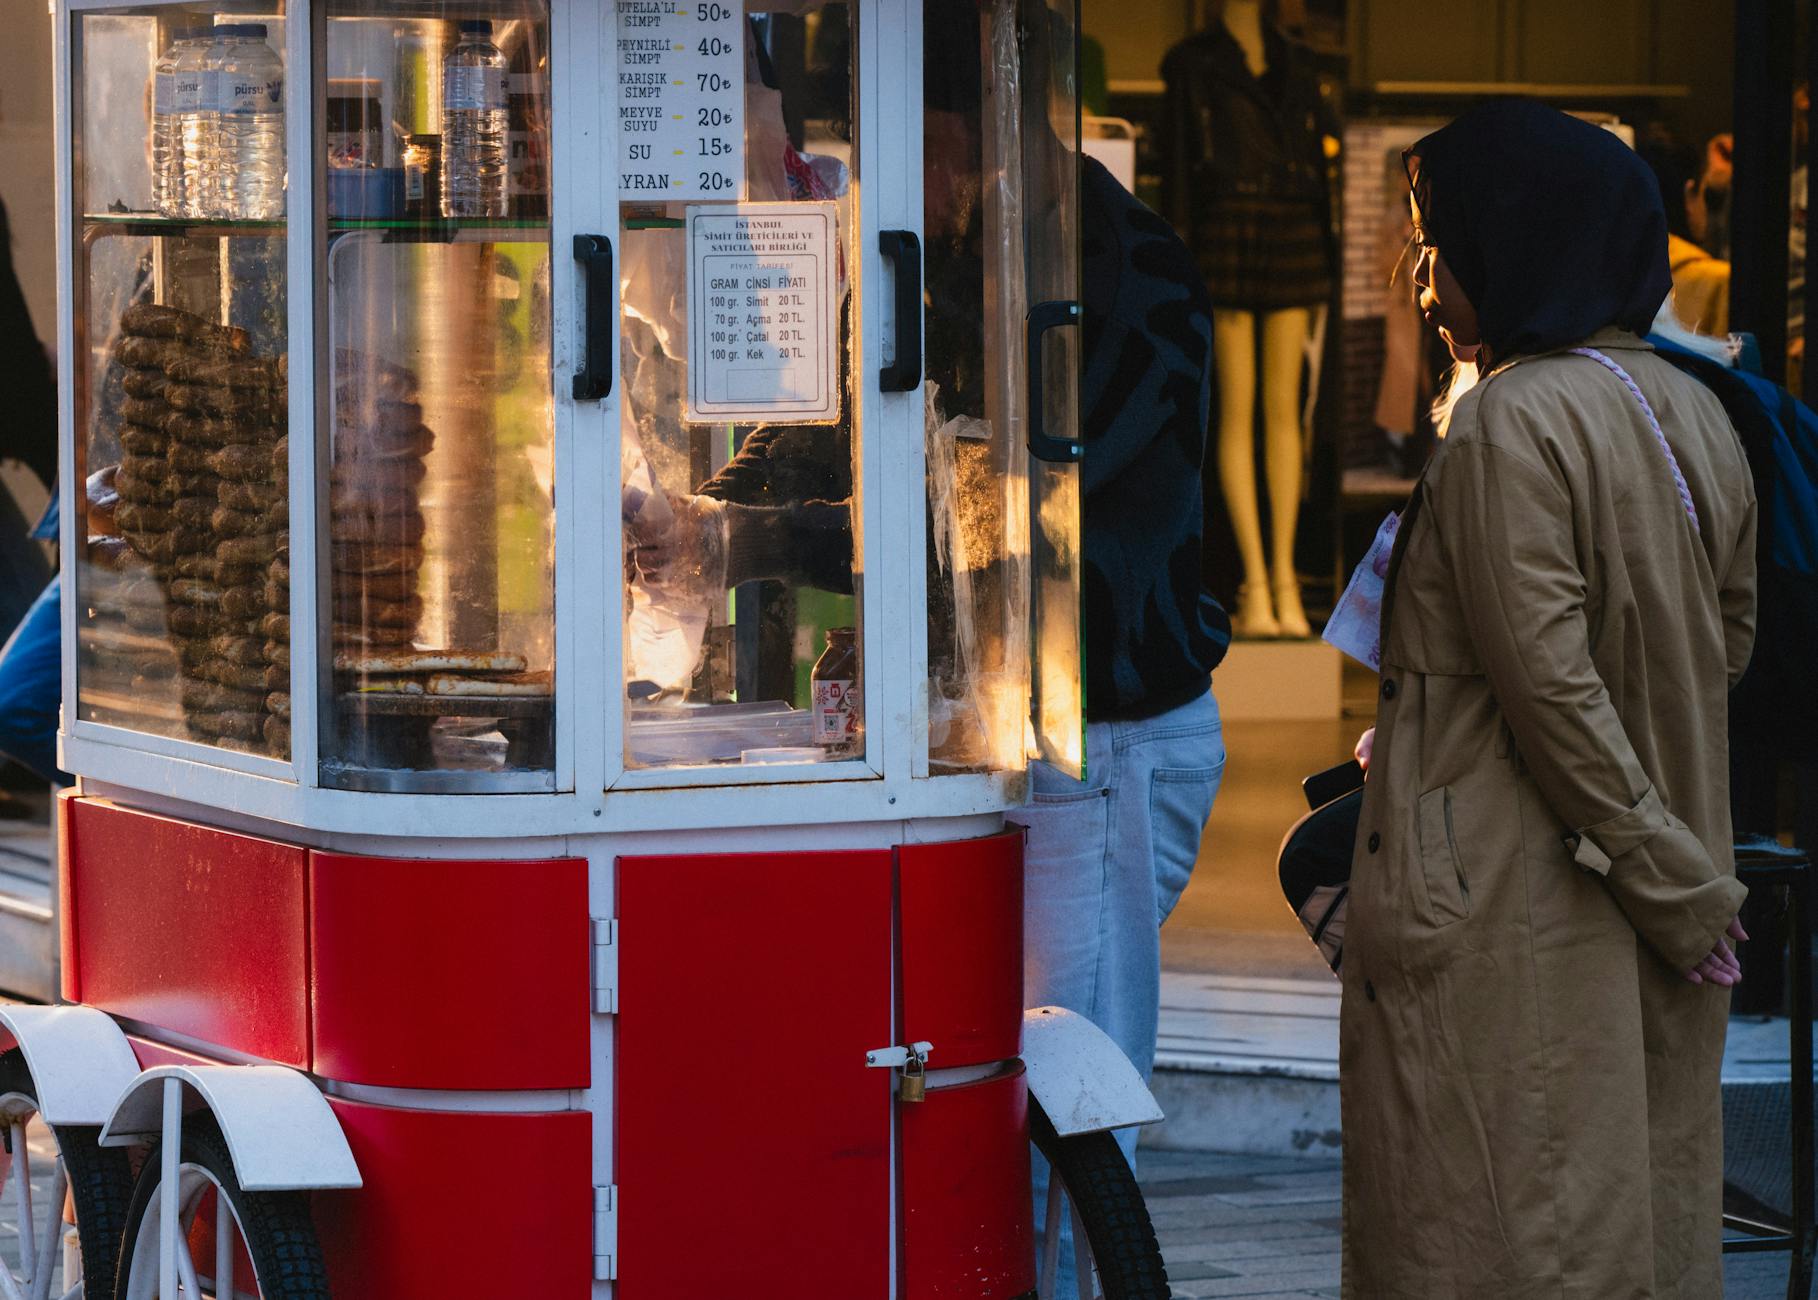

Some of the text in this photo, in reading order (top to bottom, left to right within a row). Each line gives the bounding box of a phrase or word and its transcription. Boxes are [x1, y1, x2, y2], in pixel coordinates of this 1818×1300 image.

[618, 2, 676, 14] UTELLA'LI
[624, 15, 661, 27] SİMPT
[624, 52, 661, 64] SİMPT
[619, 73, 667, 86] KARIŞIK
[625, 86, 661, 98] SİMPT
[620, 107, 662, 118] MEYVE
[624, 121, 657, 132] SUYU
[629, 144, 651, 160] SU
[618, 174, 669, 189] YRAN
[735, 220, 783, 229] İSTANBUL
[704, 231, 732, 241] SİMİT
[801, 232, 814, 240] VE
[710, 276, 806, 289] GRAM CİNSİ FİYATI
[710, 296, 725, 307] 100
[746, 295, 769, 307] Simit
[778, 295, 789, 306] 20
[715, 314, 725, 325] 70
[746, 314, 771, 327] Açma
[779, 313, 789, 323] 20
[711, 332, 725, 342] 100
[746, 331, 769, 344] Çatal
[779, 330, 789, 341] 20
[711, 349, 725, 360] 100
[747, 349, 764, 360] Kek
[779, 348, 789, 358] 20
[1368, 638, 1380, 666] 20
